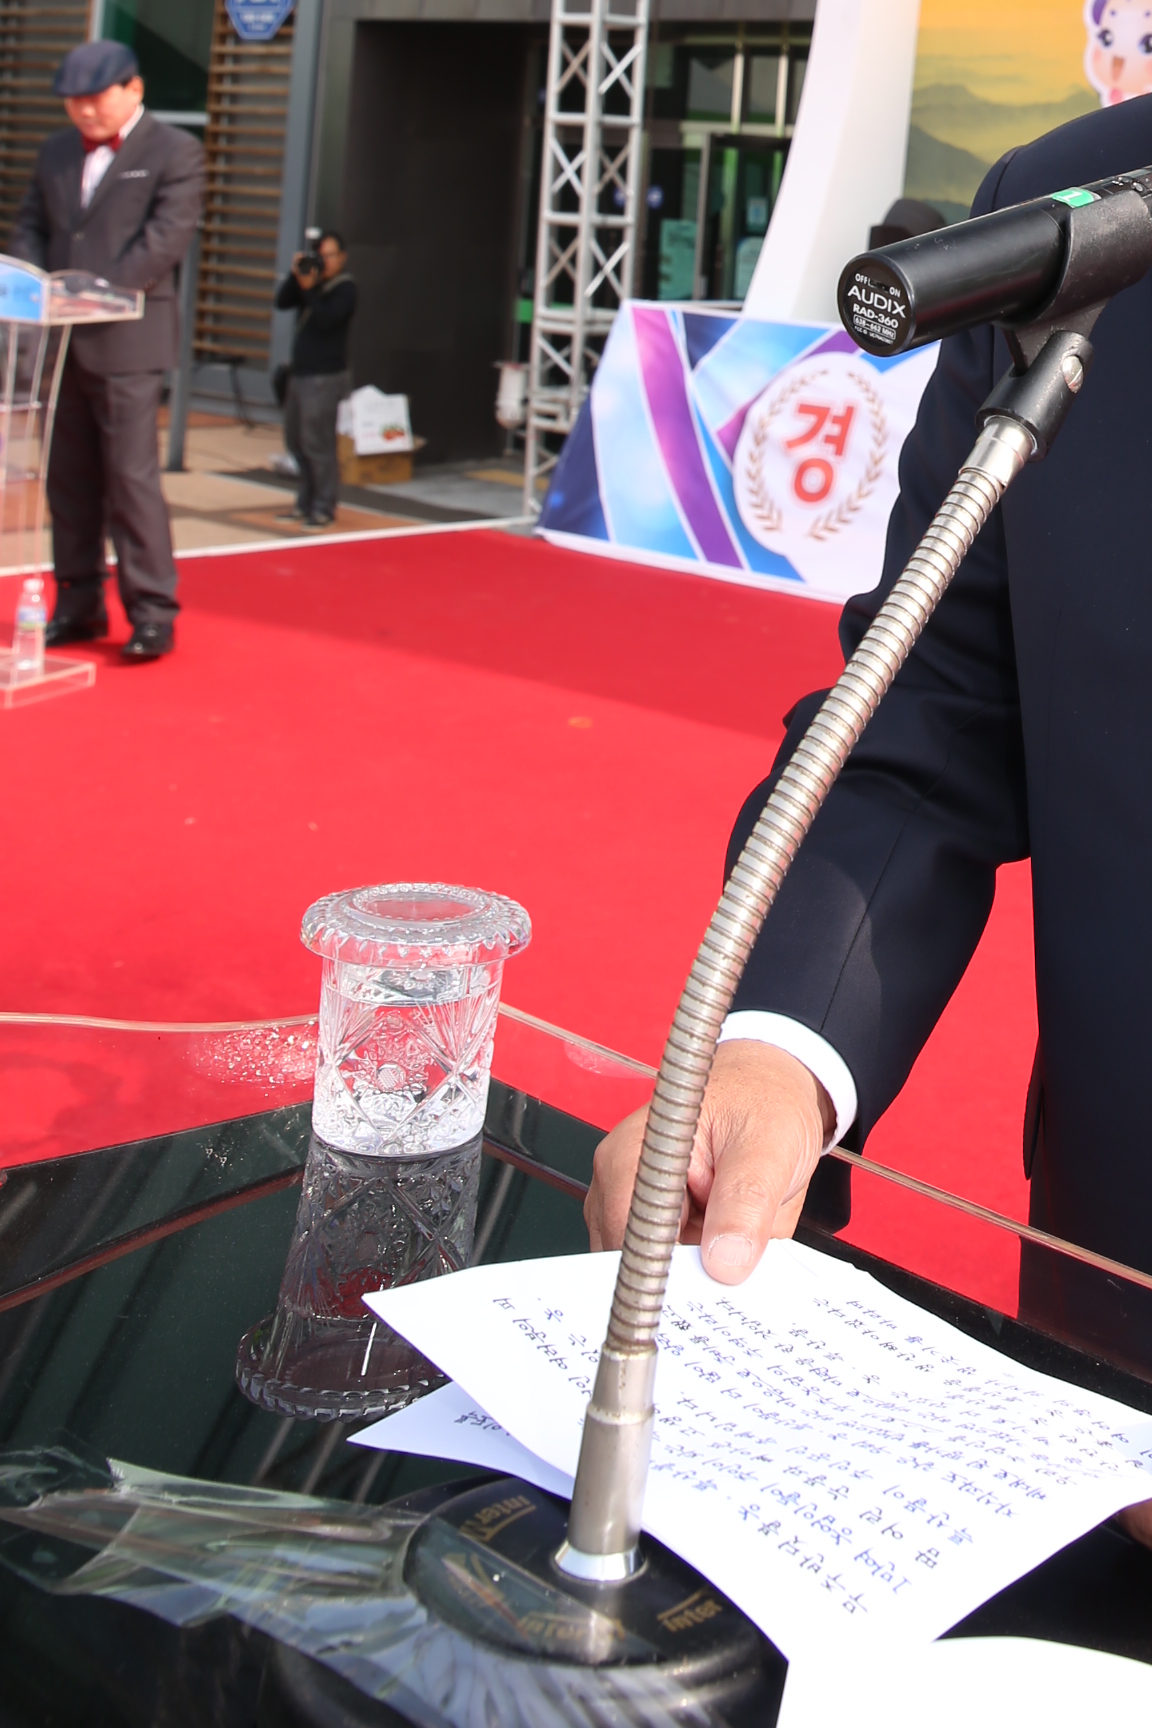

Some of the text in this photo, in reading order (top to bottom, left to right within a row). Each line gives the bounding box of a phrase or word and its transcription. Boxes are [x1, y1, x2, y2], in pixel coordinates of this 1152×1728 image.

[855, 273, 901, 298] OFF ON
[847, 285, 906, 319] AUDIX
[852, 303, 899, 329] RAD-360
[785, 402, 855, 504] 경
